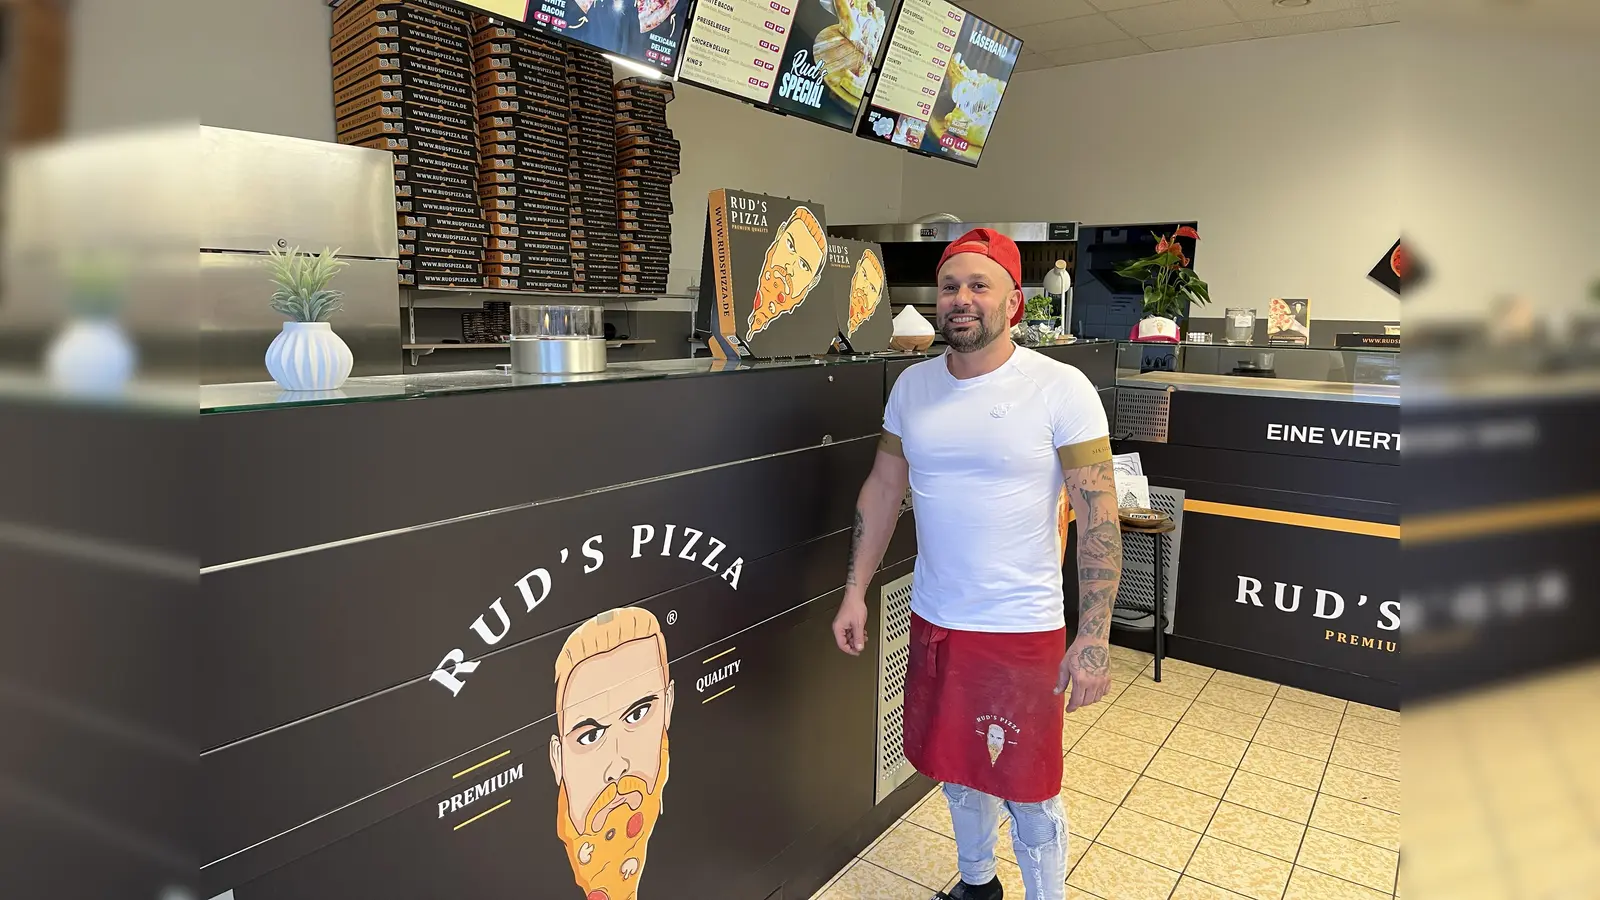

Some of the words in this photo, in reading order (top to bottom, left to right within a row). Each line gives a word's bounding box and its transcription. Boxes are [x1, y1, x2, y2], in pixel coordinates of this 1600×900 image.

[542, 4, 564, 18] BACON
[408, 13, 461, 32] WWW.RUDSPIZZA.DE
[697, 15, 731, 33] PREISELBEERE
[409, 30, 462, 47] WWW.RUDSPIZZA.DE
[649, 33, 676, 48] MEXICANA
[692, 36, 712, 48] CHICKEN
[969, 30, 1008, 58] KÄSERAND
[410, 46, 463, 63] WWW.RUDSPIZZA.DE
[651, 43, 671, 55] DELUXE
[410, 62, 464, 78] WWW.RUDSPIZZA.DE
[791, 50, 828, 85] Rud's
[413, 77, 466, 93] WWW.RUDSPIZZA.DE
[779, 72, 824, 108] SPECIAL
[413, 93, 467, 109] WWW.RUDSPIZZA.DE
[413, 110, 467, 125] WWW.RUDSPIZZA.DE
[415, 126, 468, 140] WWW.RUDSPIZZA.DE
[418, 141, 470, 156] WWW.RUDSPIZZA.DE
[419, 157, 469, 170] WWW.RUDSPIZZA.DE
[416, 173, 467, 184] WWW.RUDSPIZZA.DE
[422, 188, 472, 198] WWW.RUDSPIZZA.DE
[423, 204, 474, 213] WWW.RUDSPIZZA.DE
[730, 196, 767, 212] RUD'S
[437, 219, 485, 228] WWW.RUDSPIZZA.DE
[731, 211, 768, 226] PIZZA
[427, 233, 477, 241] WWW.RUDSPIZZA.DE
[425, 247, 475, 255] WWW.RUDSPIZZA.DE
[828, 244, 848, 254] RUD'S
[715, 206, 730, 317] WWW.RUDSPIZZA.DE
[829, 254, 850, 264] PIZZA
[1266, 424, 1324, 444] EINE
[429, 534, 604, 697] RUD'S
[631, 524, 745, 590] PIZZA
[1235, 575, 1400, 631] RUD'S
[696, 659, 742, 693] QUALITY
[1000, 717, 1020, 733] PIZZA
[437, 763, 524, 818] PREMIUM
